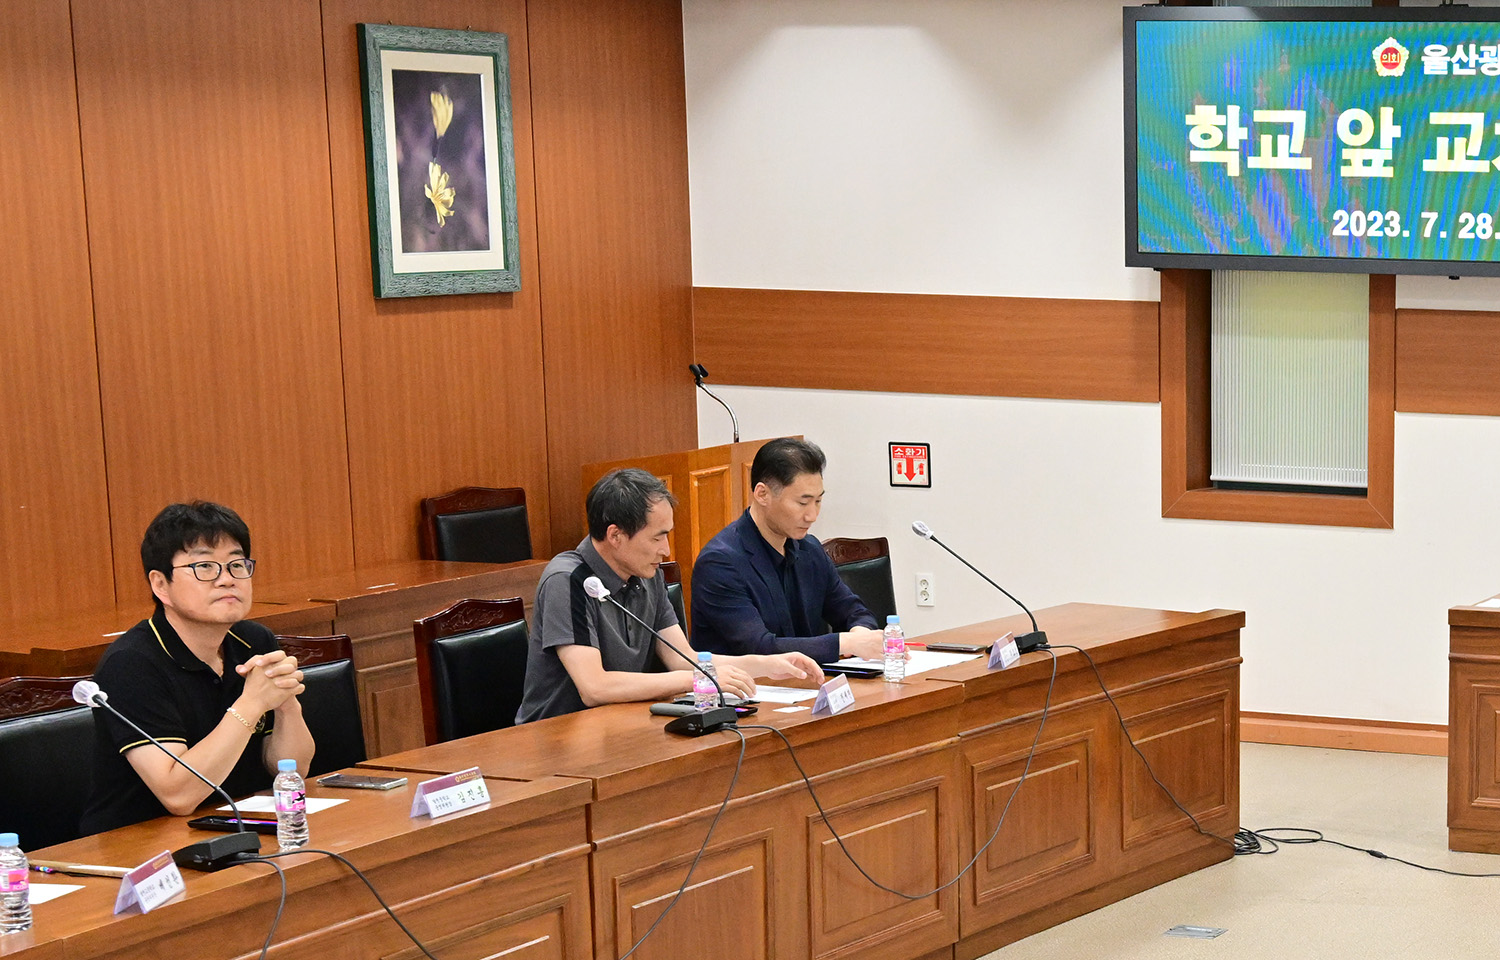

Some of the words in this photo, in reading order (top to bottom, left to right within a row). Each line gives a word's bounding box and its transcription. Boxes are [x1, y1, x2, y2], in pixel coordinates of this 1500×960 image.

[1185, 104, 1313, 177] 학교
[1336, 106, 1402, 179] 앞
[1333, 211, 1409, 239] 2023.
[1421, 211, 1447, 240] 7.
[894, 448, 925, 456] 소화기
